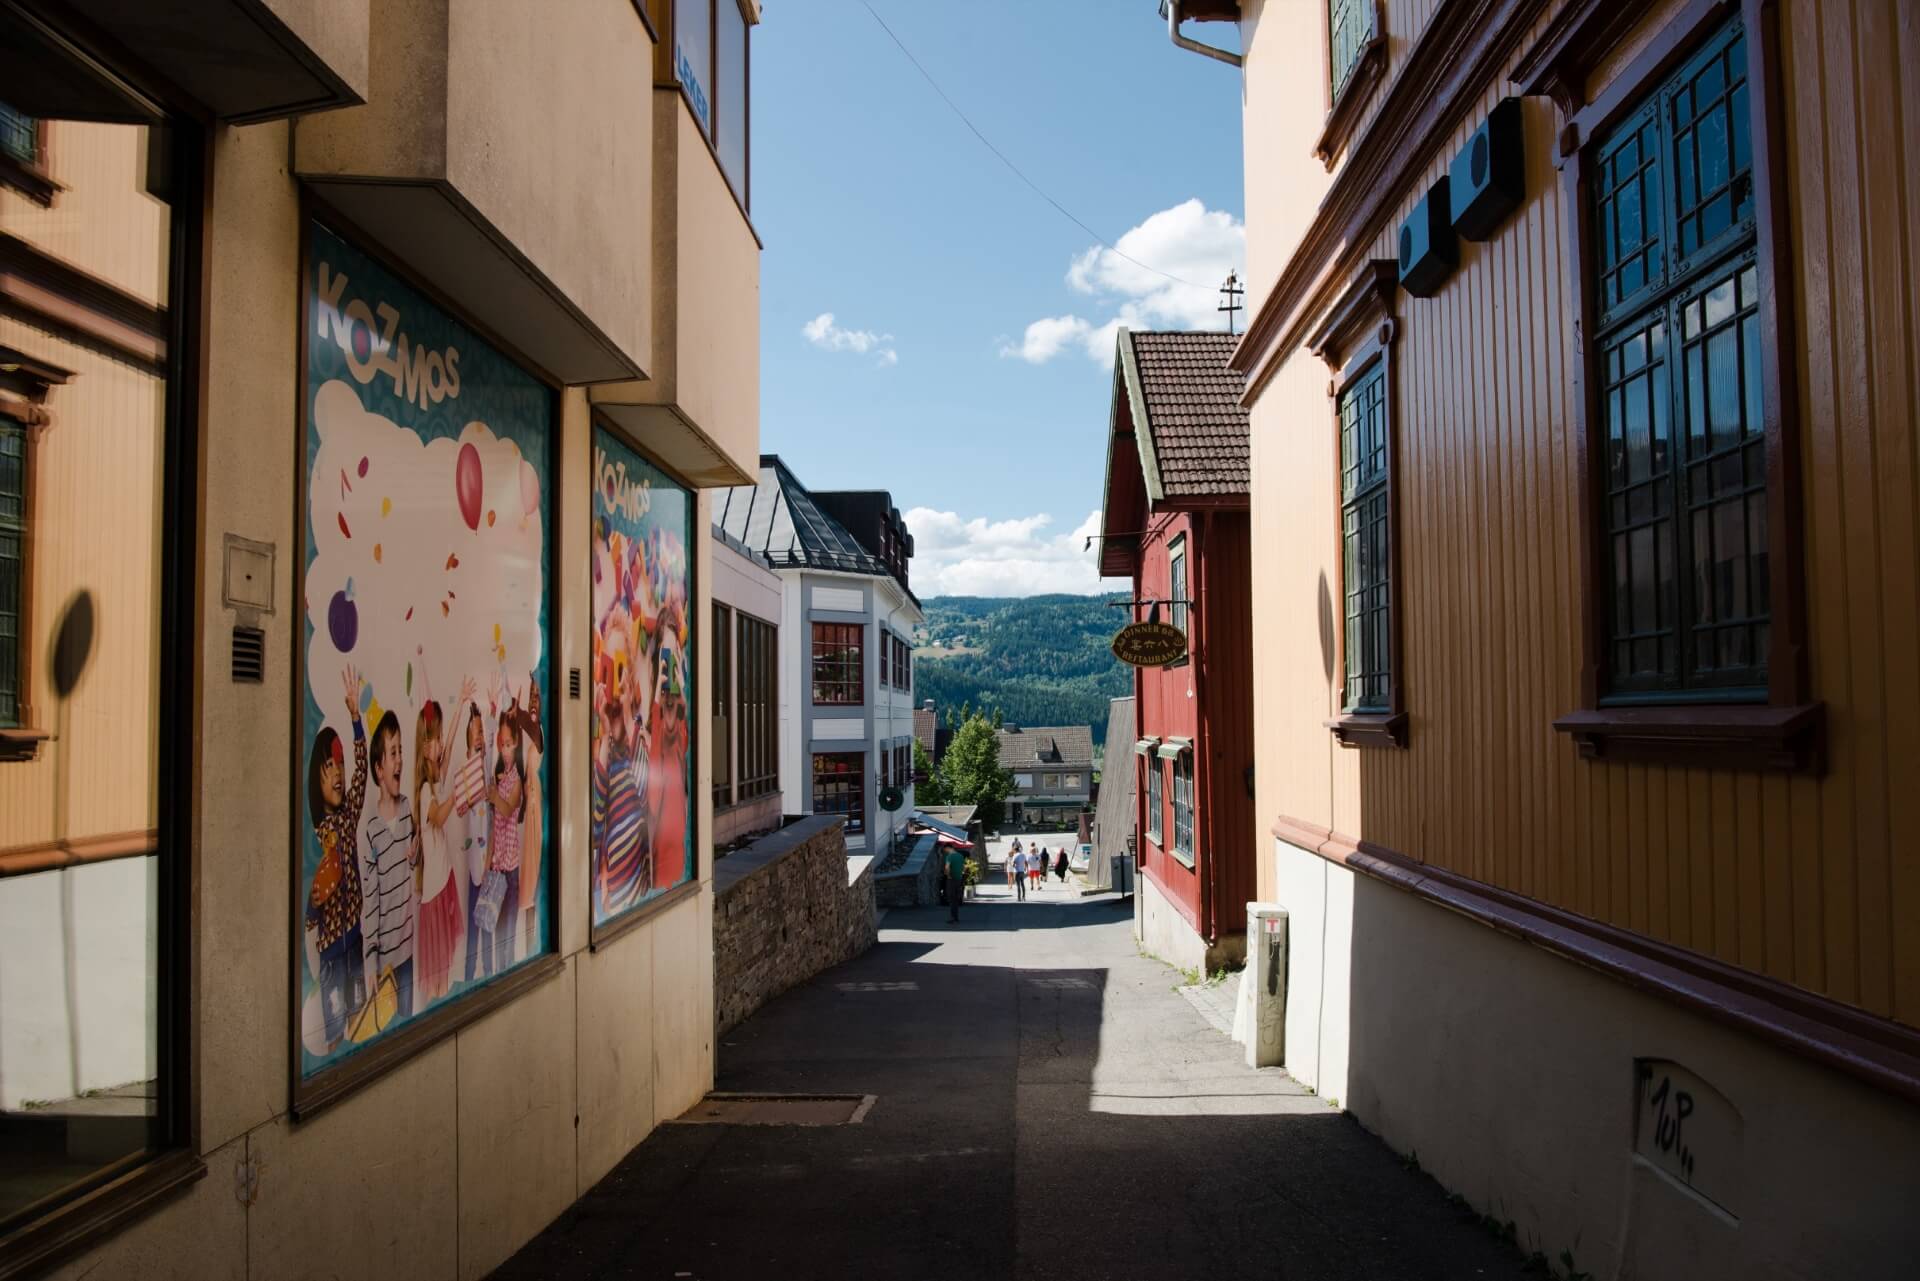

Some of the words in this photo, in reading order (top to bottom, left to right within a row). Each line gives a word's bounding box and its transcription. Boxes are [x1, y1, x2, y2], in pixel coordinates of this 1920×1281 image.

[677, 43, 708, 129] LEKER
[317, 261, 460, 411] KOZMOS
[594, 445, 650, 524] KOZMOS
[1121, 649, 1177, 665] RESTAURANT
[1123, 624, 1159, 639] DINNER
